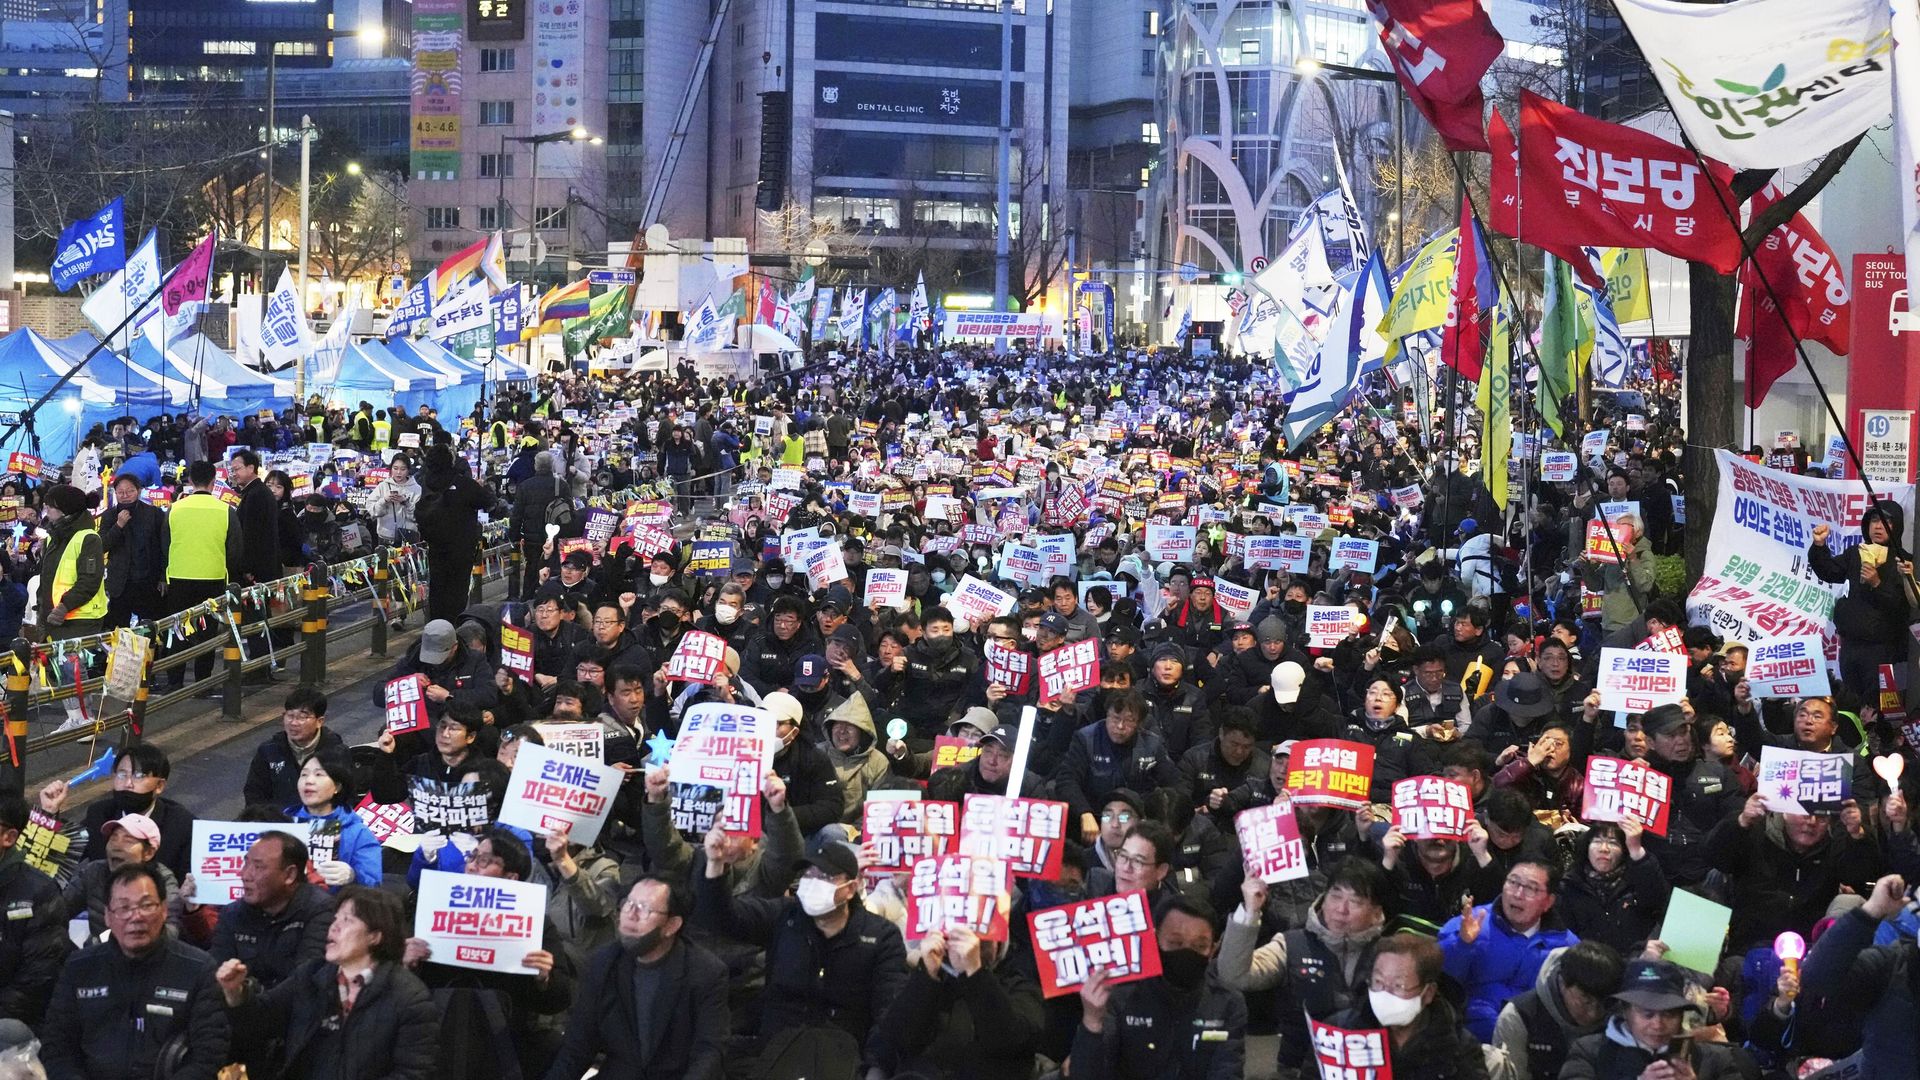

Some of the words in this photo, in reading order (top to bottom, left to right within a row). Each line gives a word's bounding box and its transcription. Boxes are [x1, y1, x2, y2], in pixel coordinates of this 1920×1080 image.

[857, 103, 892, 112] DENTAL
[894, 105, 924, 113] CLINIC
[940, 102, 960, 115] 치과
[941, 88, 961, 104] 참빛
[1554, 136, 1701, 210] 진보당
[1633, 213, 1653, 232] 시
[1675, 216, 1696, 237] 당
[1786, 222, 1850, 306] 보당
[1865, 262, 1895, 270] SEOUL
[1865, 271, 1887, 280] CITY
[1865, 280, 1884, 289] BUS
[956, 324, 1003, 335] 내란세력
[1870, 419, 1887, 436] 19
[1729, 461, 1769, 500] 광화문
[1765, 475, 1800, 513] 전광훈
[1733, 496, 1771, 537] 여의도
[1773, 510, 1805, 549] 손현보
[633, 523, 674, 550] 윤석열
[871, 572, 896, 582] 헌재는
[1719, 554, 1762, 586] 윤석열
[1758, 571, 1801, 603] 김건희
[965, 583, 1003, 605] 윤석열은
[1217, 582, 1249, 600] 윤석열은
[1312, 611, 1350, 622] 윤석열은
[1039, 641, 1096, 677] 윤석열
[1755, 642, 1806, 662] 윤석열은
[1612, 657, 1670, 673] 윤석열은
[1749, 659, 1817, 681] 즉각파면!
[1044, 664, 1093, 698] 파면!
[1605, 676, 1677, 693] 즉각파면!
[688, 713, 756, 733] 윤석열은
[1304, 747, 1358, 771] 윤석열
[1801, 757, 1844, 782] 즉각
[540, 759, 600, 788] 헌재는
[702, 768, 732, 780] 진보당
[1288, 770, 1323, 790] 즉각
[1327, 773, 1369, 796] 파면!
[1588, 757, 1670, 803] 윤석열
[1764, 768, 1797, 782] 윤석열
[452, 793, 488, 808] 윤석열
[522, 780, 607, 817] 파면선고!
[1394, 778, 1470, 811] 윤석열
[1799, 780, 1842, 803] 파면
[413, 800, 489, 828] 즉각파면
[866, 802, 956, 836] 윤석열
[966, 796, 1063, 840] 윤석열
[1593, 786, 1660, 828] 파면!
[1398, 806, 1466, 837] 파면!
[872, 835, 949, 867] 파면!
[911, 857, 1008, 897] 윤석열
[448, 884, 517, 911] 헌재는
[430, 910, 533, 938] 파면선고!
[915, 895, 995, 935] 파면!
[1033, 892, 1149, 951] 윤석열
[457, 948, 492, 962] 진보당
[1049, 935, 1141, 988] 파면!
